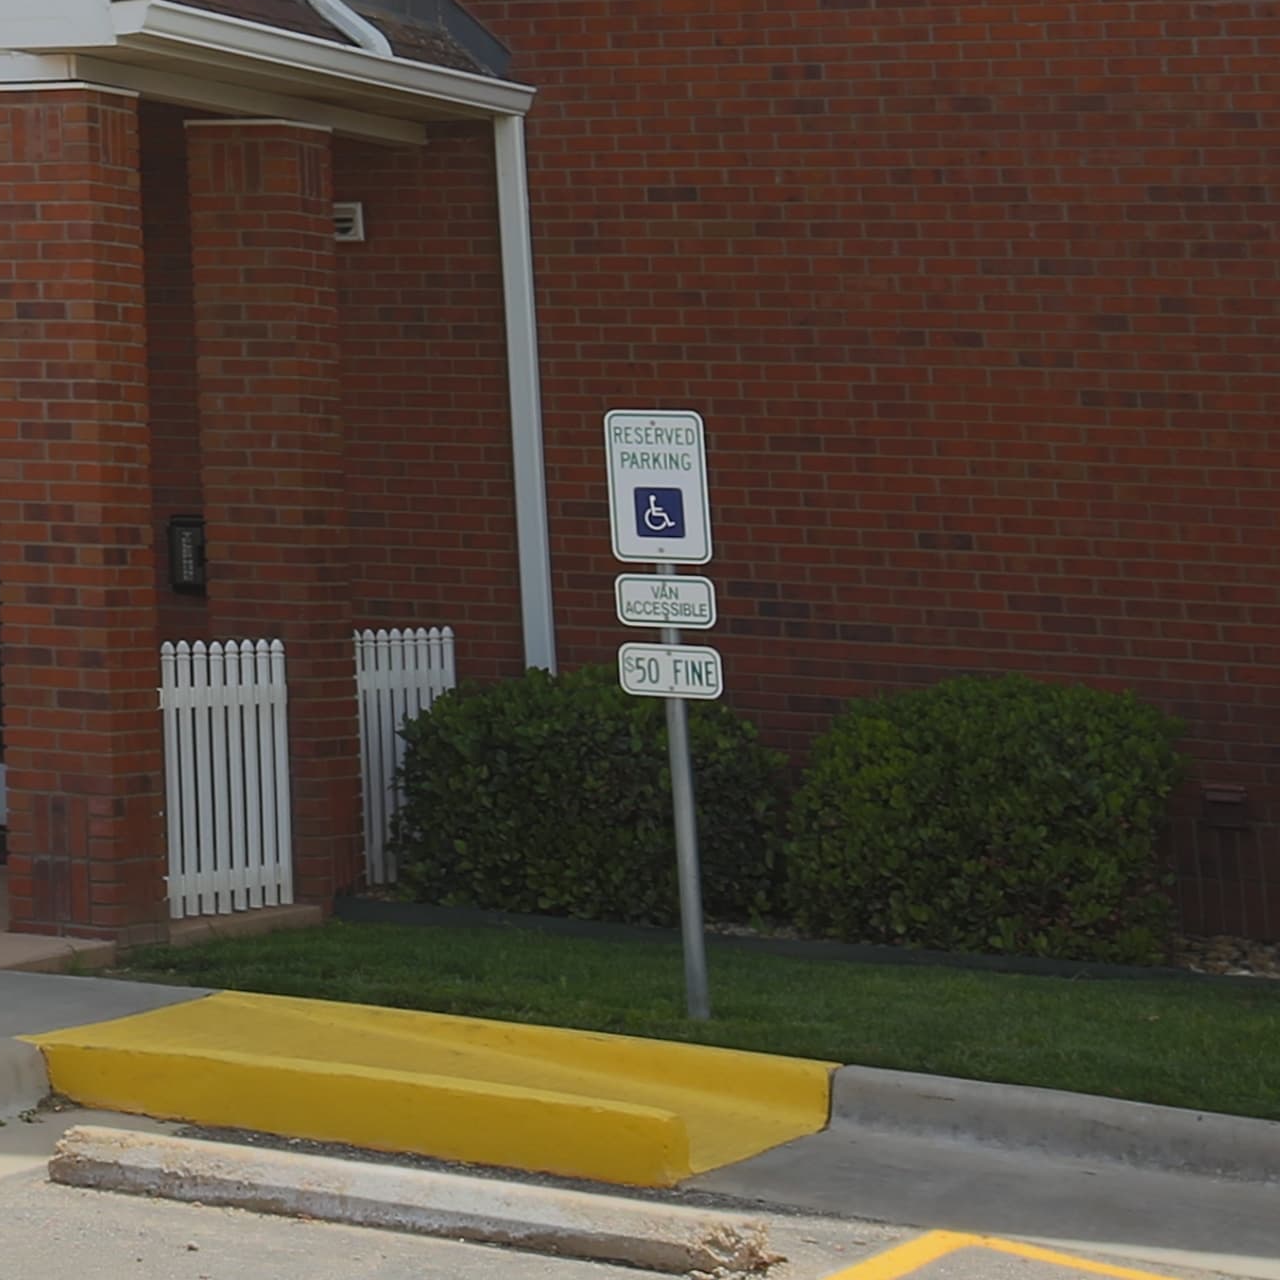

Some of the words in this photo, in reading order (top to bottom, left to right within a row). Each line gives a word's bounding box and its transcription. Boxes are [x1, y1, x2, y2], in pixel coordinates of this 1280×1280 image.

[613, 426, 696, 446] RESERVED
[620, 451, 692, 471] PARKING
[650, 585, 680, 600] VAN
[625, 600, 708, 618] ACCESSIBLE
[624, 656, 660, 685] $50
[672, 659, 716, 687] FINE
